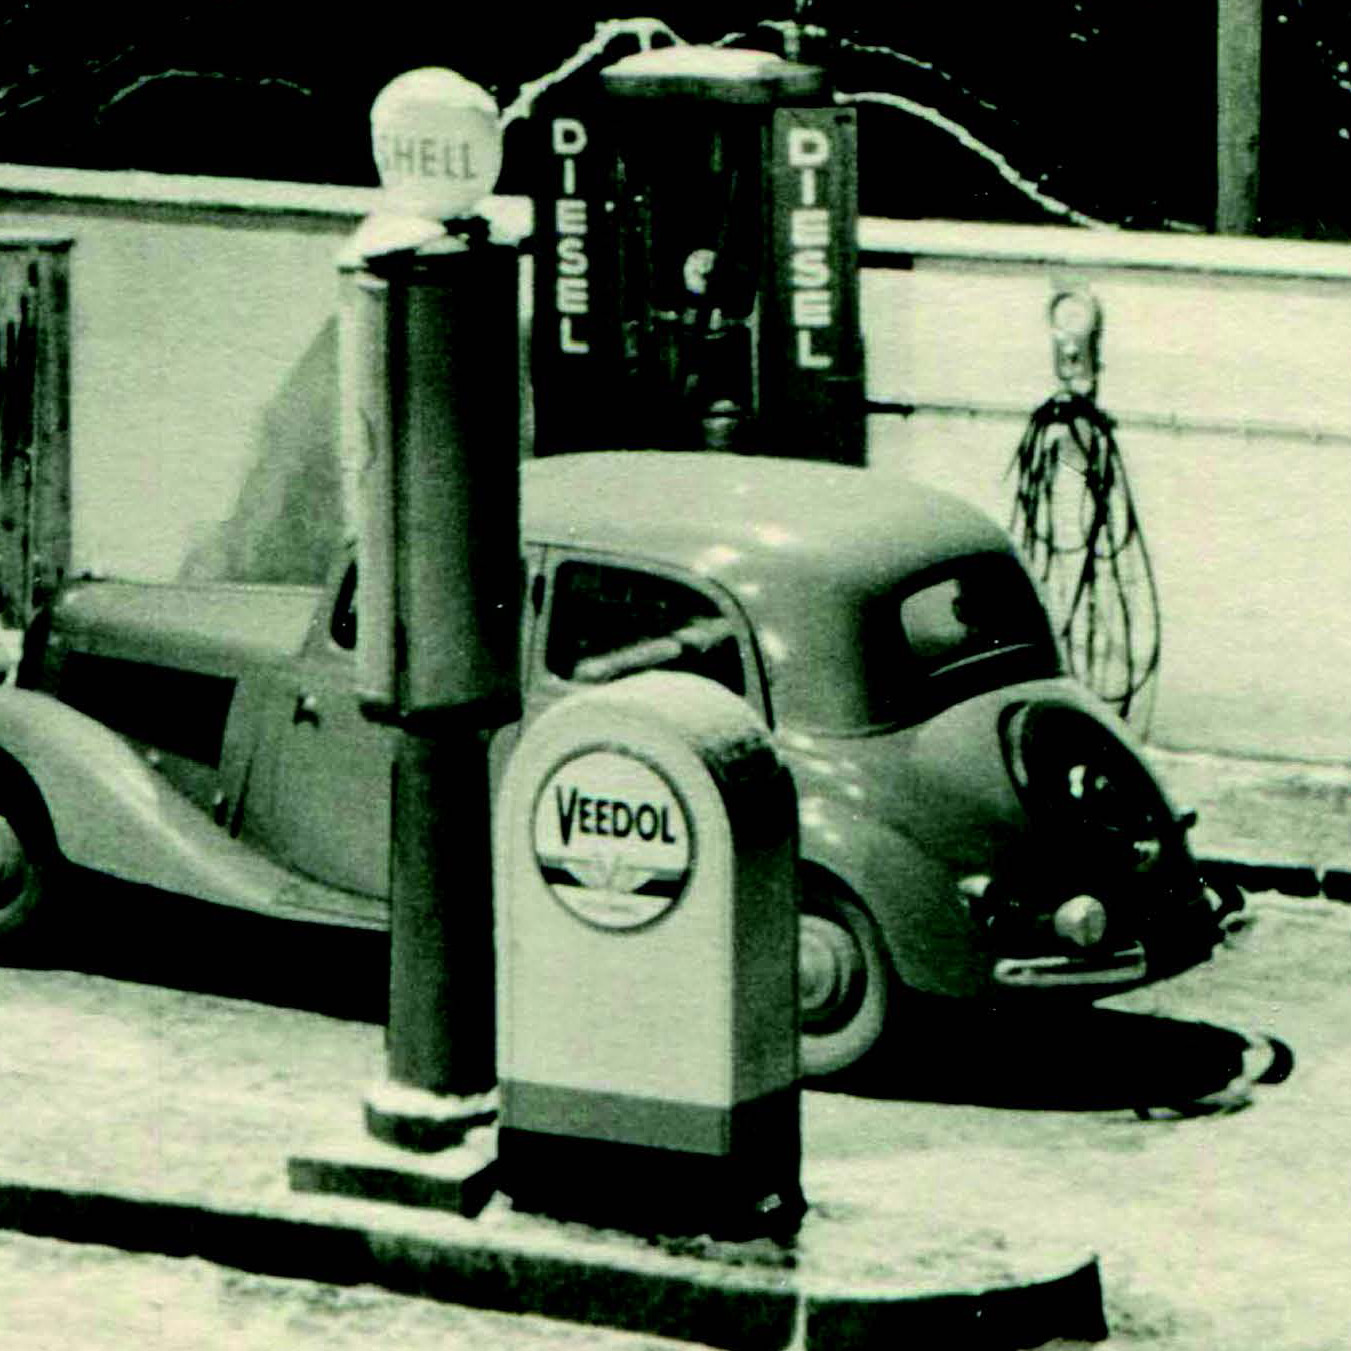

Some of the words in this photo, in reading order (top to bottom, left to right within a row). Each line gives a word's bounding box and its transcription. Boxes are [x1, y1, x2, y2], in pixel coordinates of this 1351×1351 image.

[552, 118, 590, 354] DIESEL
[788, 127, 833, 368] DIESEL
[556, 785, 675, 846] VEEDOL
